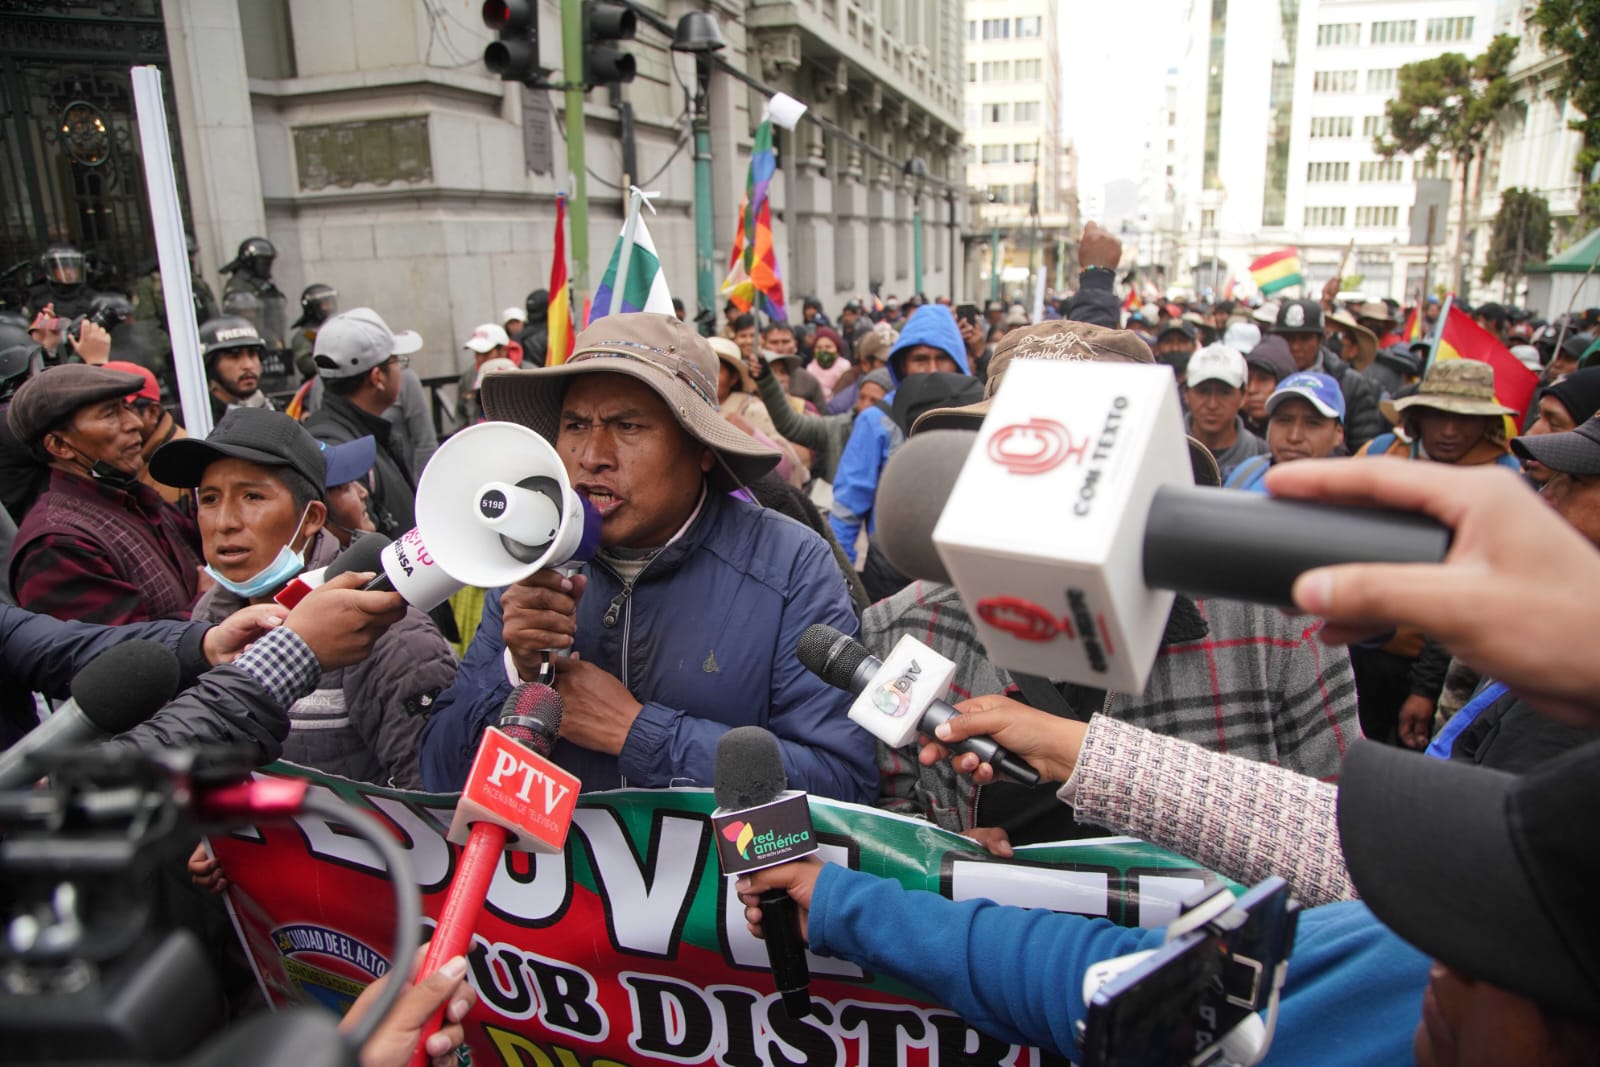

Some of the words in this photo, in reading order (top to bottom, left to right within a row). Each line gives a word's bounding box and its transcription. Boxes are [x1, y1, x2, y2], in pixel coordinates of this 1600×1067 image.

[482, 499, 505, 510] 519B
[487, 747, 569, 815] PTV
[752, 829, 774, 845] red
[753, 831, 810, 855] américa
[287, 929, 324, 951] CIUDAD
[324, 931, 340, 955] DE
[340, 937, 355, 961] EL
[356, 946, 386, 978] ALTO
[420, 920, 608, 1042] UB
